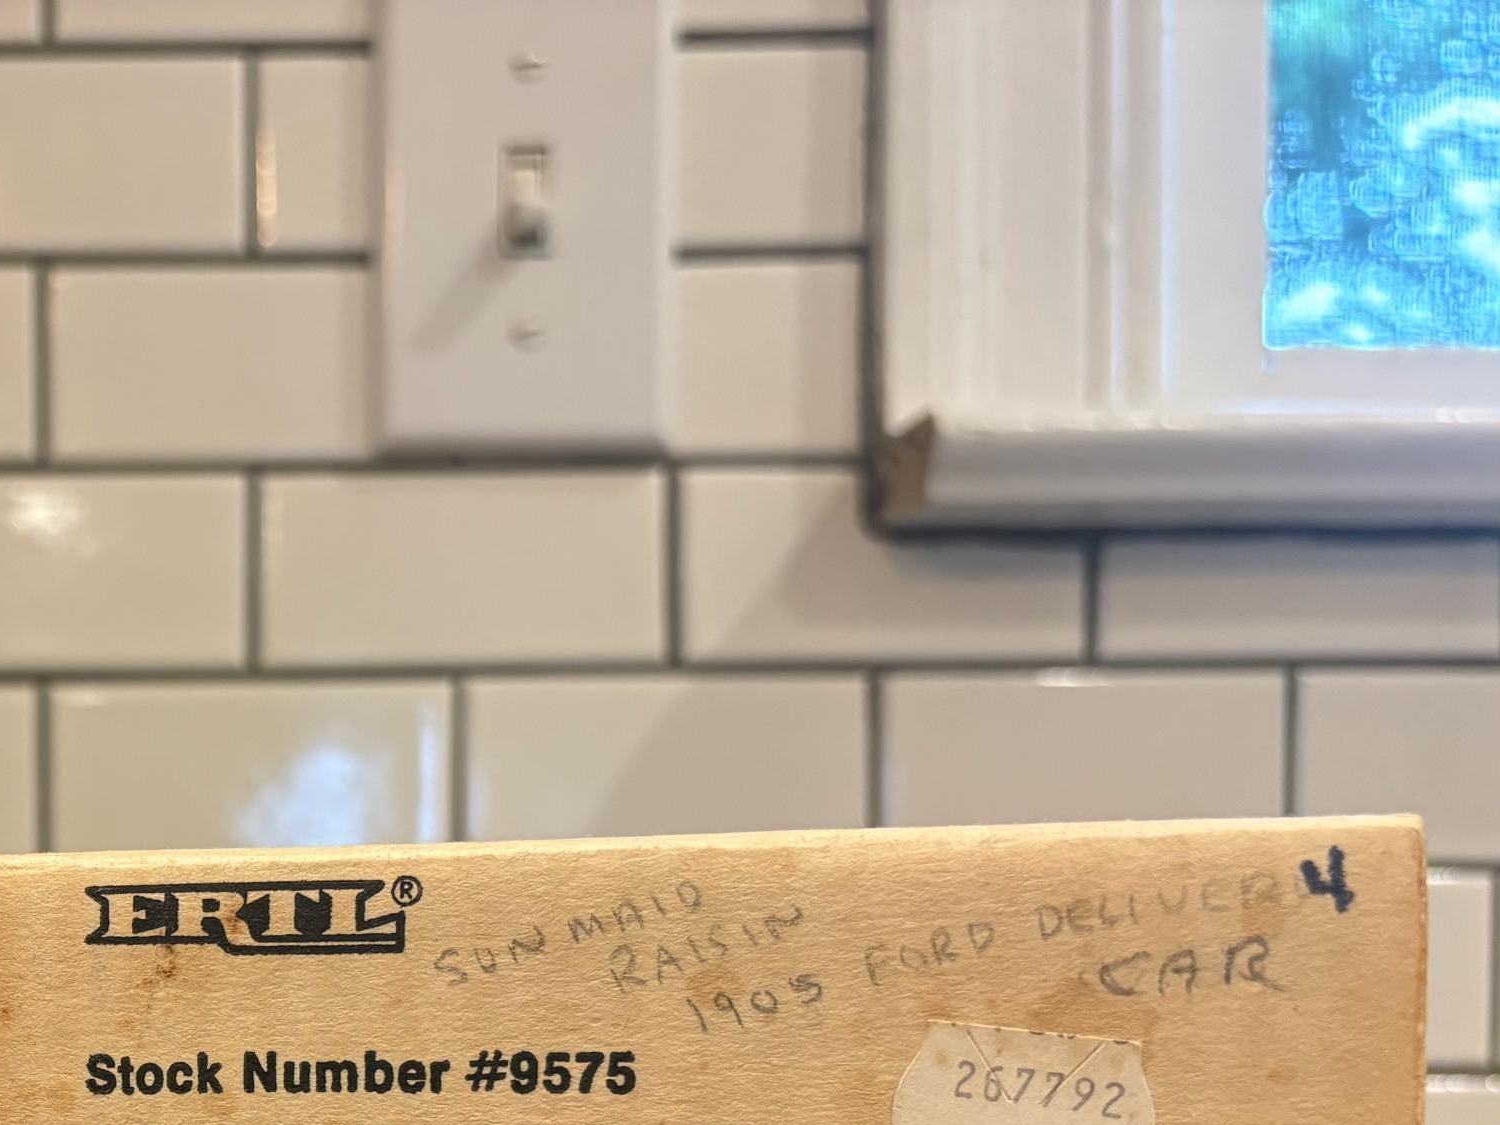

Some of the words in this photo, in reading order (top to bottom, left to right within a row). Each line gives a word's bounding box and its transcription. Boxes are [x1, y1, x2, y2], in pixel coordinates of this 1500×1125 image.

[1300, 845, 1356, 914] 4
[433, 924, 546, 987] SUN
[567, 879, 702, 945] MAID
[608, 903, 803, 994] RAISIN
[1100, 934, 1292, 997] CAR
[686, 973, 823, 1032] 1905
[864, 921, 994, 986] FORD
[86, 1051, 224, 1095] Stock
[243, 1050, 450, 1094] Number
[465, 1050, 637, 1095] #9575
[954, 1060, 1126, 1119] 267792
